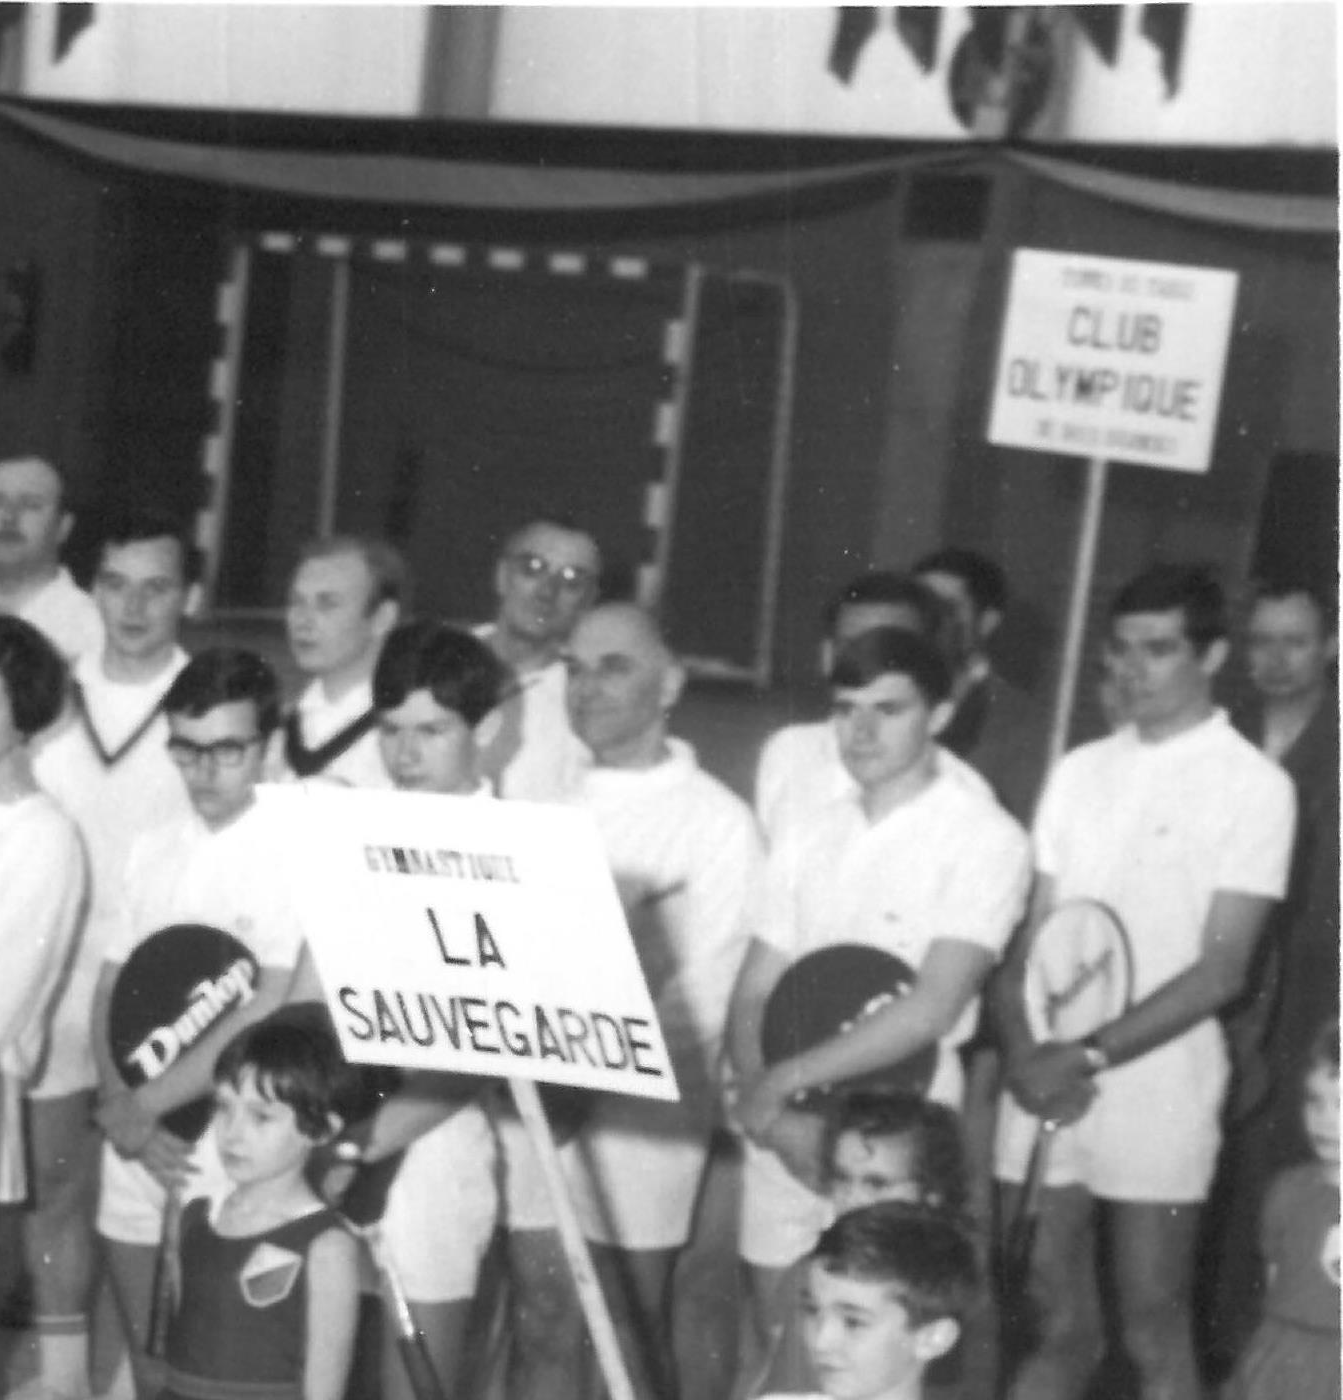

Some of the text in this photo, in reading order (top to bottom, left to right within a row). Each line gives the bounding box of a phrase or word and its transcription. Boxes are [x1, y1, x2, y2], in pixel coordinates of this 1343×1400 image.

[1067, 305, 1161, 354] CLUB
[1009, 358, 1202, 422] OLYMPIQUE
[427, 907, 506, 969] LA
[127, 958, 254, 1080] Dunlop
[338, 986, 663, 1077] SAUVEGARDE
